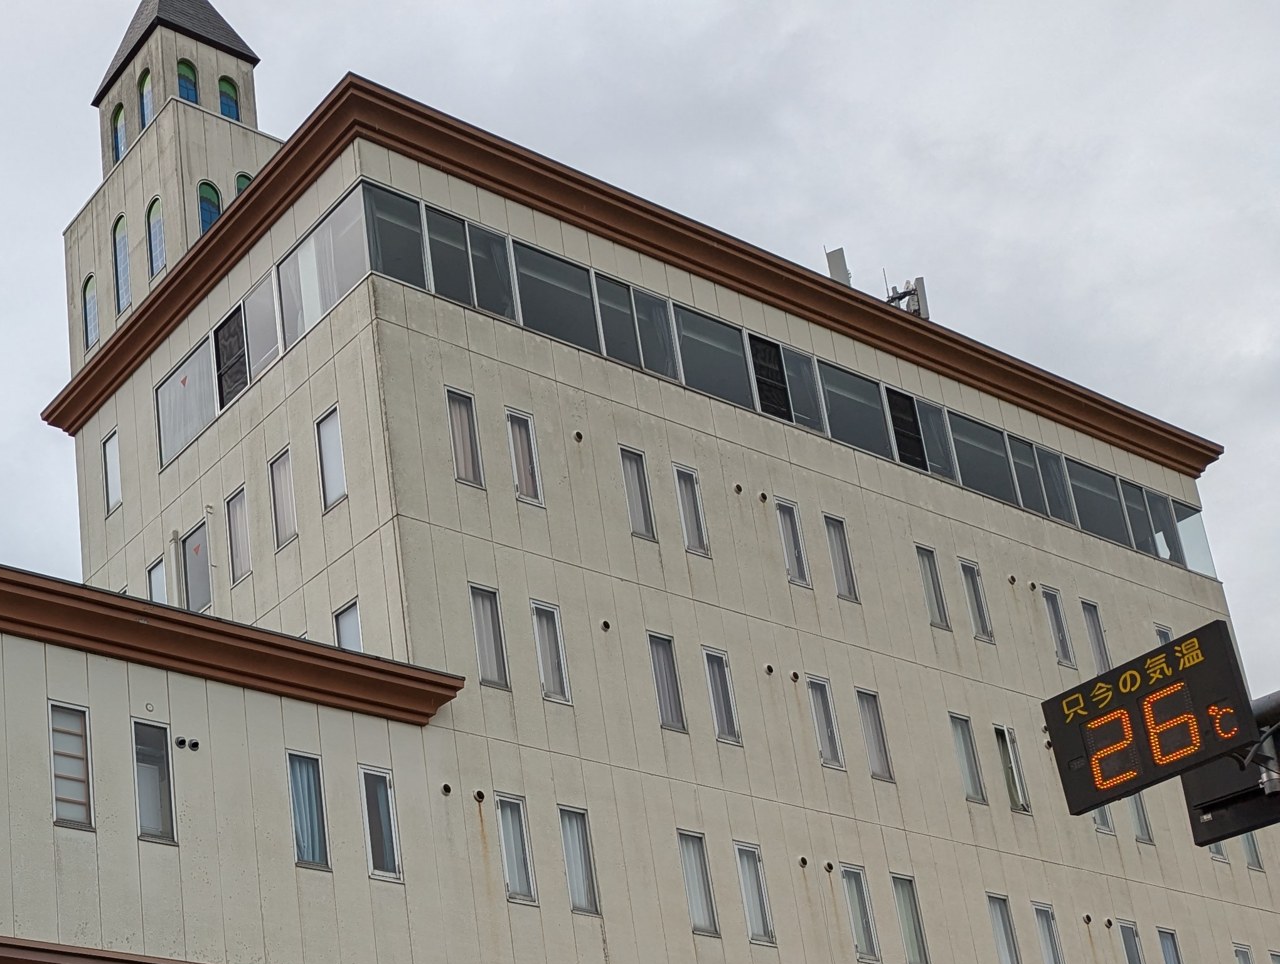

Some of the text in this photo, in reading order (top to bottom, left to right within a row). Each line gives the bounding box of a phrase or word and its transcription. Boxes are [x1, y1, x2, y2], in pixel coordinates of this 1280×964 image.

[1062, 637, 1205, 724] 只今の気温
